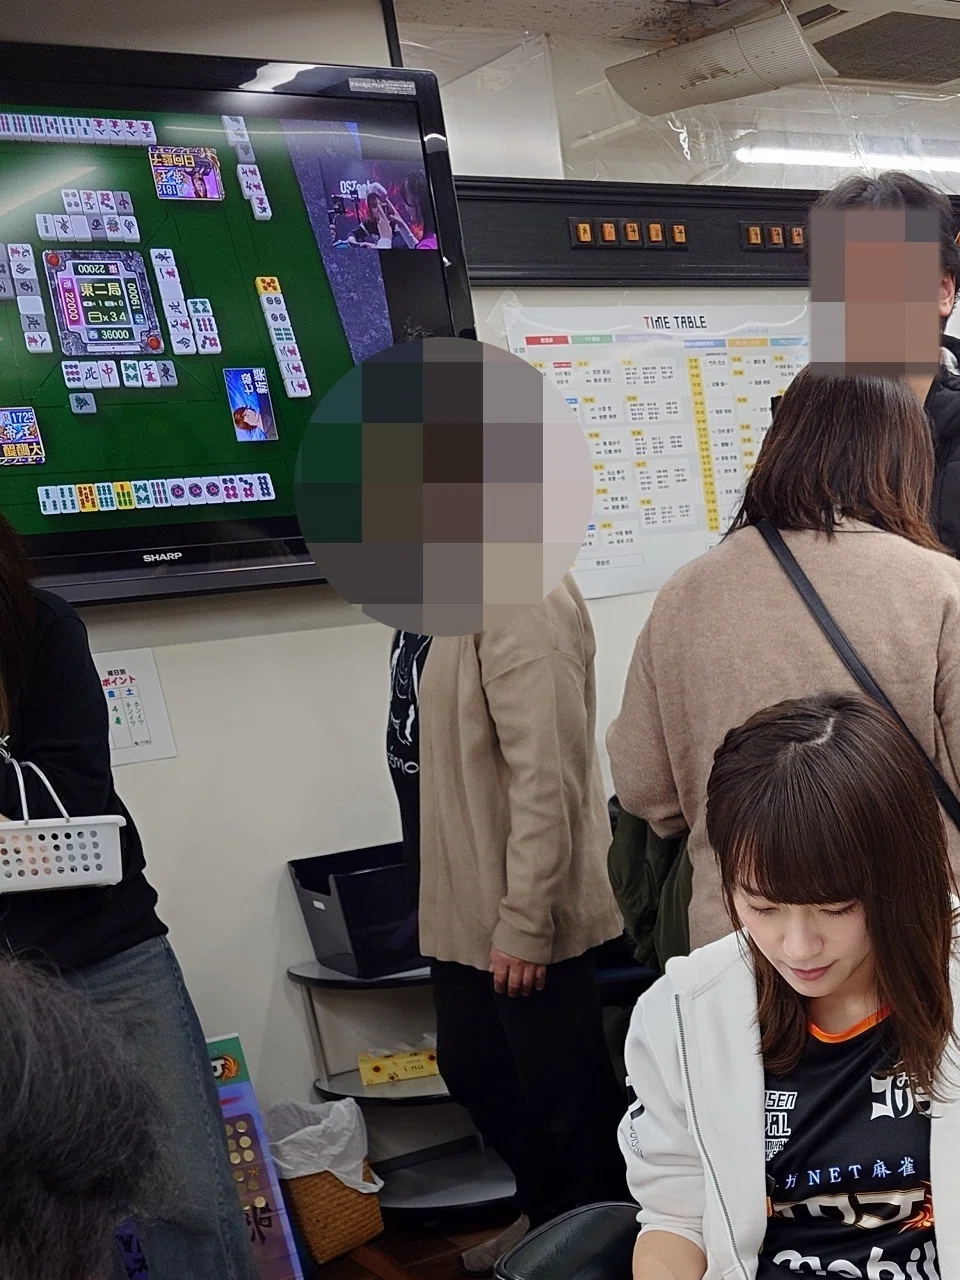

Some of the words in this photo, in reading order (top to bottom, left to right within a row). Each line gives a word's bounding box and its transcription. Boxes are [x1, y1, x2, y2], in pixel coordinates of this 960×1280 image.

[80, 282, 122, 296] 東二局
[643, 316, 671, 330] TIME
[673, 315, 708, 330] TABLE
[101, 330, 129, 340] 36000
[12, 411, 35, 423] 1725
[142, 552, 183, 563] SHARP
[102, 675, 136, 687] ポイント
[126, 688, 135, 696] 土
